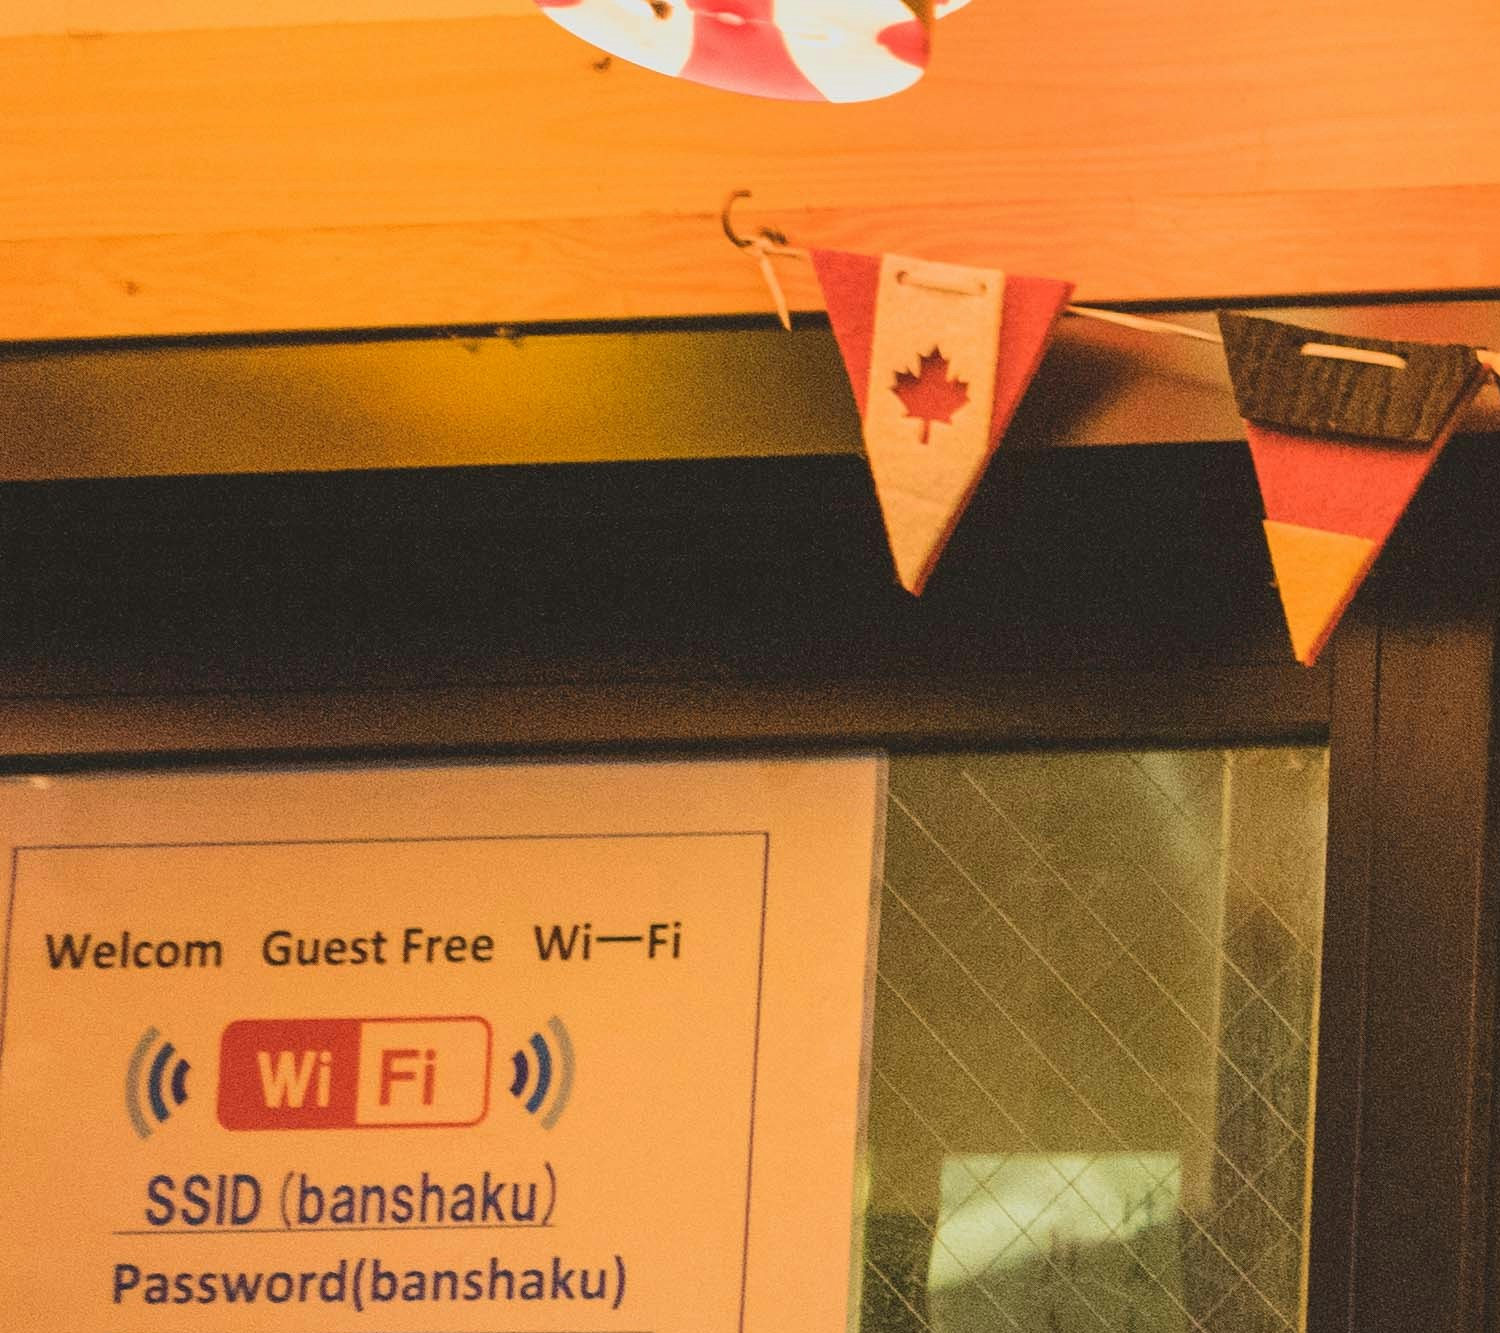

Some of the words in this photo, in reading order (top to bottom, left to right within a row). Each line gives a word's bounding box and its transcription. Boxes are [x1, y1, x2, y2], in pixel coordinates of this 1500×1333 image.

[45, 929, 224, 971] Welcom
[262, 927, 387, 968] Guest
[403, 927, 496, 964] Free
[145, 1171, 262, 1227] SSID
